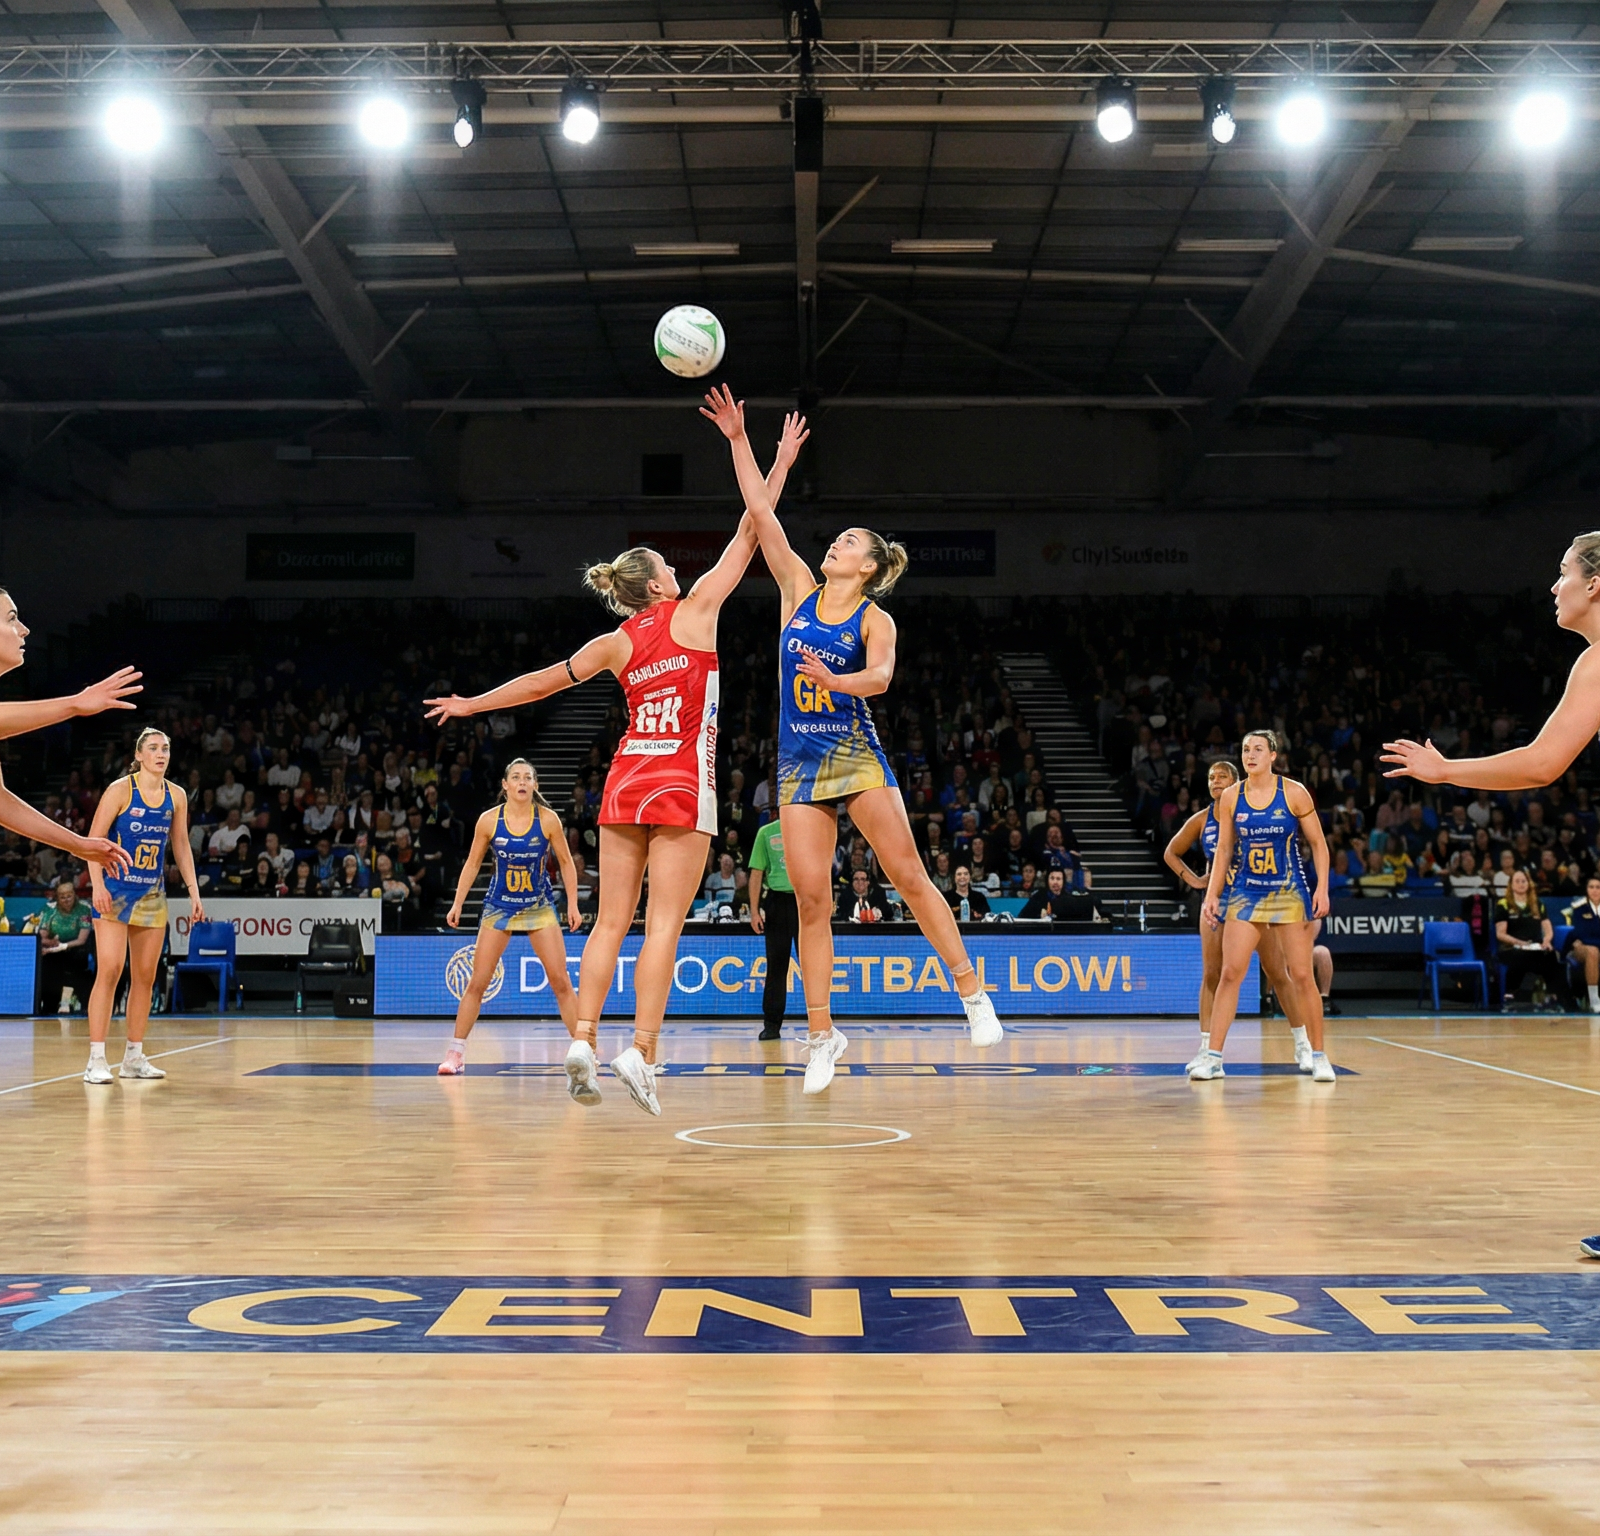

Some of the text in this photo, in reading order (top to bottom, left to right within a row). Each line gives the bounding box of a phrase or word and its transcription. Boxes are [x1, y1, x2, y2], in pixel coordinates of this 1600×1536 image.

[793, 673, 836, 714] GA
[635, 696, 683, 734] GK
[1248, 847, 1279, 875] GA
[1009, 955, 1132, 993] LOW!
[187, 1286, 1550, 1337] CENTRE
